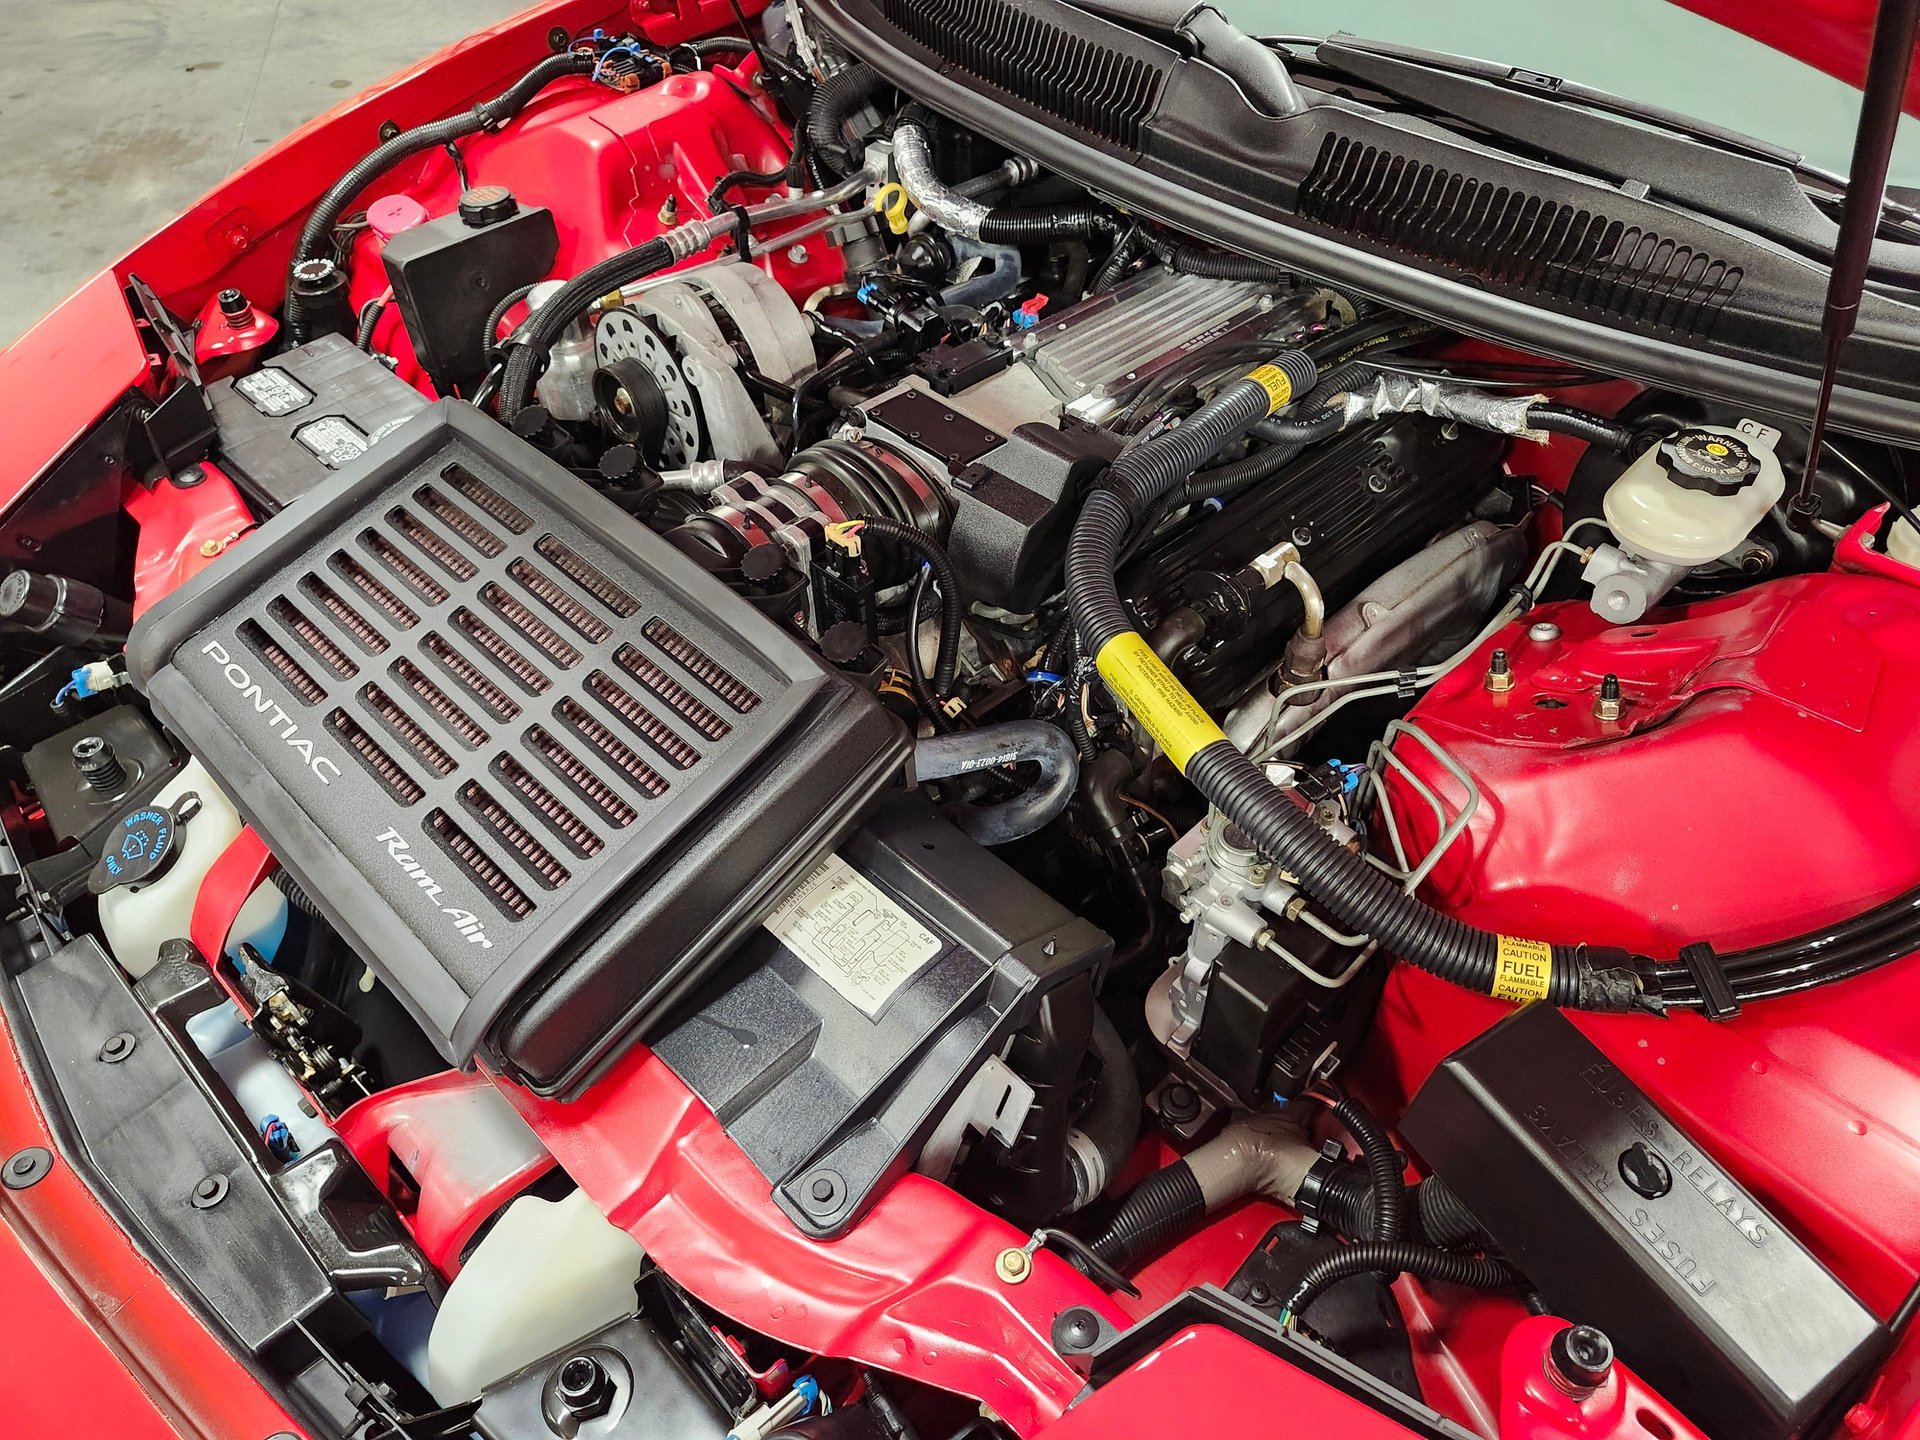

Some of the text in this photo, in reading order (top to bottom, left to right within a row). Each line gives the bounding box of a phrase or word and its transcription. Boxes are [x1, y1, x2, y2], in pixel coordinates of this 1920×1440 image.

[1266, 376, 1286, 392] FUEL
[1742, 422, 1770, 438] C F
[1694, 434, 1746, 458] WARNING
[1700, 466, 1717, 474] DOT
[1720, 467, 1740, 475] ONLY
[1133, 650, 1200, 726] BY RETAINER STRAP TO HELP AVOID
[1136, 664, 1183, 718] POTENTIAL FIRE HAZARD
[1158, 671, 1171, 686] MUST
[1175, 690, 1188, 704] HELD
[1190, 707, 1205, 724] PLACE
[202, 640, 342, 785] PONTIAC
[1133, 694, 1152, 715] CAUTION
[124, 812, 167, 860] WASHER FLUID
[106, 854, 123, 875] ONLY
[375, 826, 493, 949] Ram Air
[918, 932, 934, 946] CAF
[1502, 940, 1546, 952] FLAMMABLE
[1503, 948, 1547, 962] CAUTION
[1503, 960, 1544, 979] FUEL
[1498, 985, 1542, 997] CAUTION
[1500, 974, 1544, 988] FLAMMABLE
[1580, 1064, 1769, 1244] FUSES RELAYS
[1531, 1103, 1716, 1293] FUSES RELAYS
